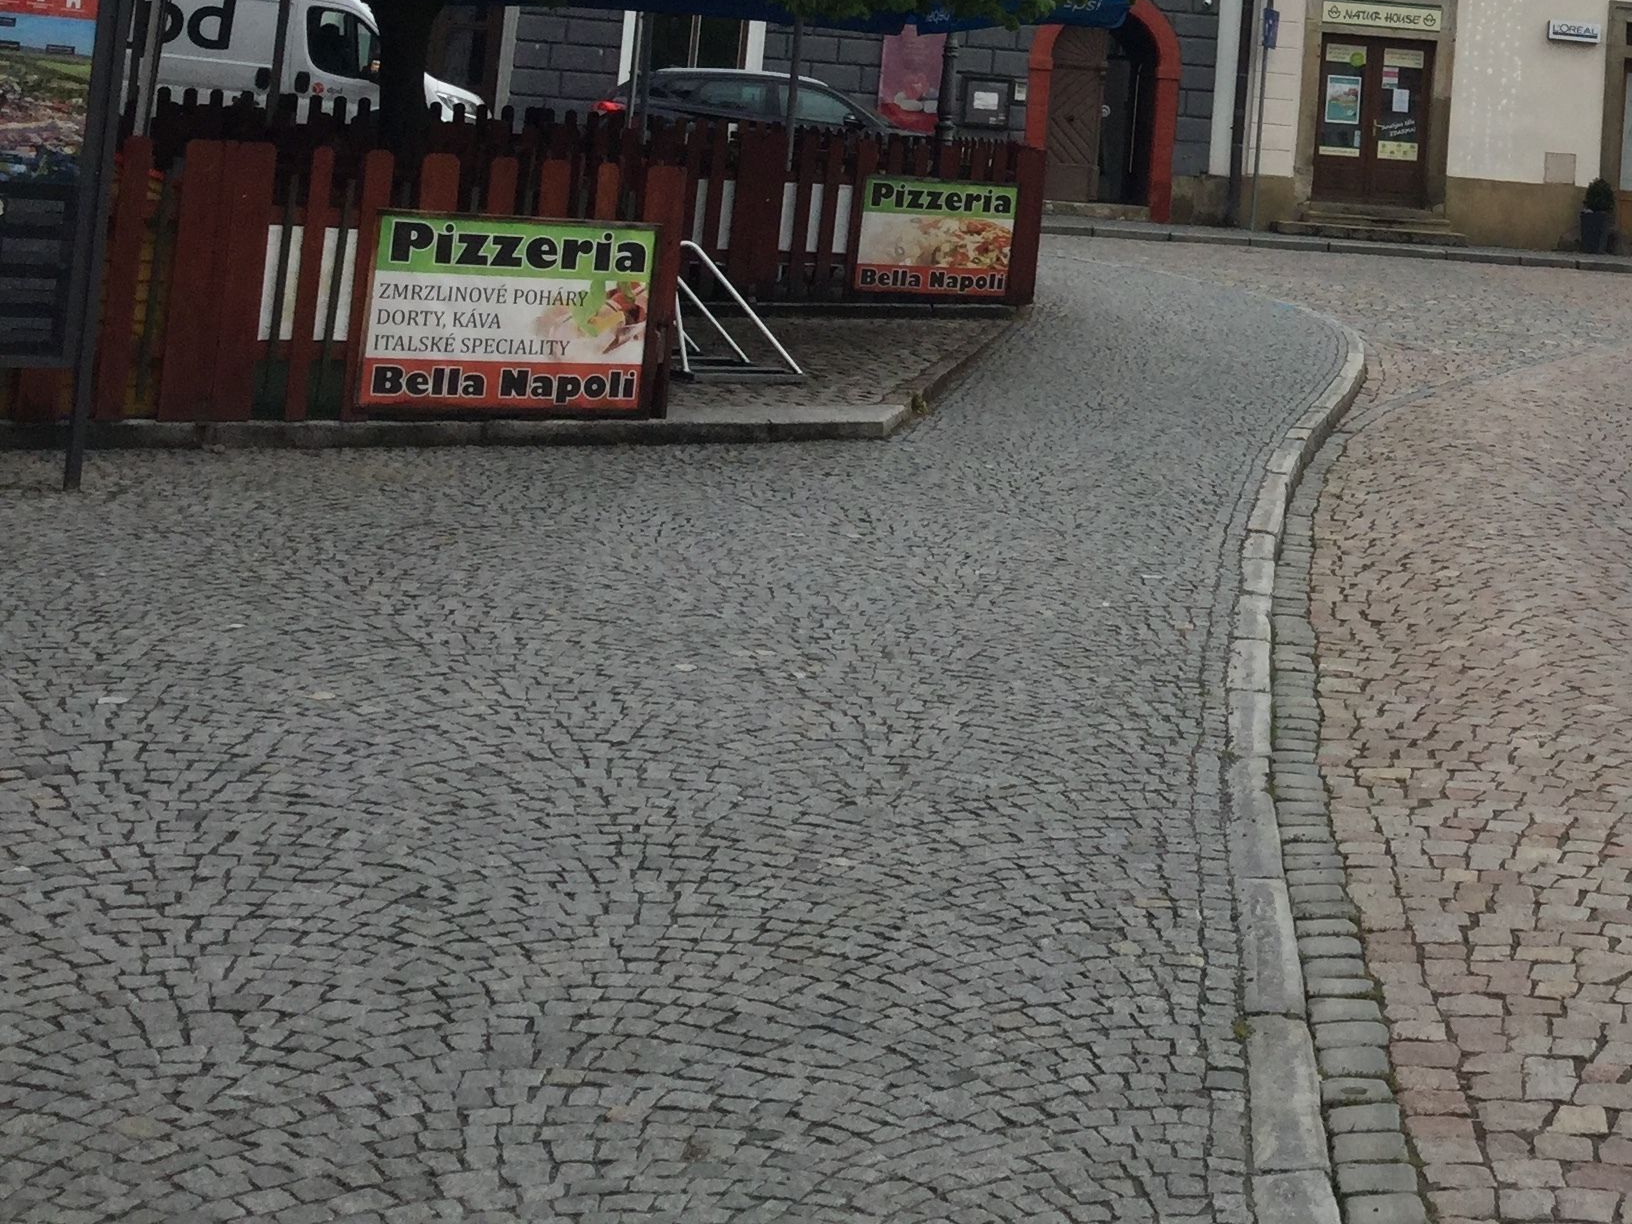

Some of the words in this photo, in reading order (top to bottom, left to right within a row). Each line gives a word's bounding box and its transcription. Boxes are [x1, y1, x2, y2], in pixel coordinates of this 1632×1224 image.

[1343, 9, 1381, 22] NATUR
[1384, 12, 1421, 25] HOUSE
[871, 182, 1012, 214] Pizzeria
[391, 220, 647, 273] Pizzeria
[860, 268, 922, 287] Bella
[928, 271, 1006, 293] Napoli
[378, 283, 508, 304] ZMRZLINOVÉ
[513, 287, 588, 307] POHÁRY
[376, 309, 446, 330] DORTY,
[453, 310, 501, 329] KÁVA
[374, 333, 455, 353] ITALSKÉ
[460, 337, 570, 356] SPECIALITY
[371, 365, 486, 397] Bella
[499, 368, 637, 404] Napoli
